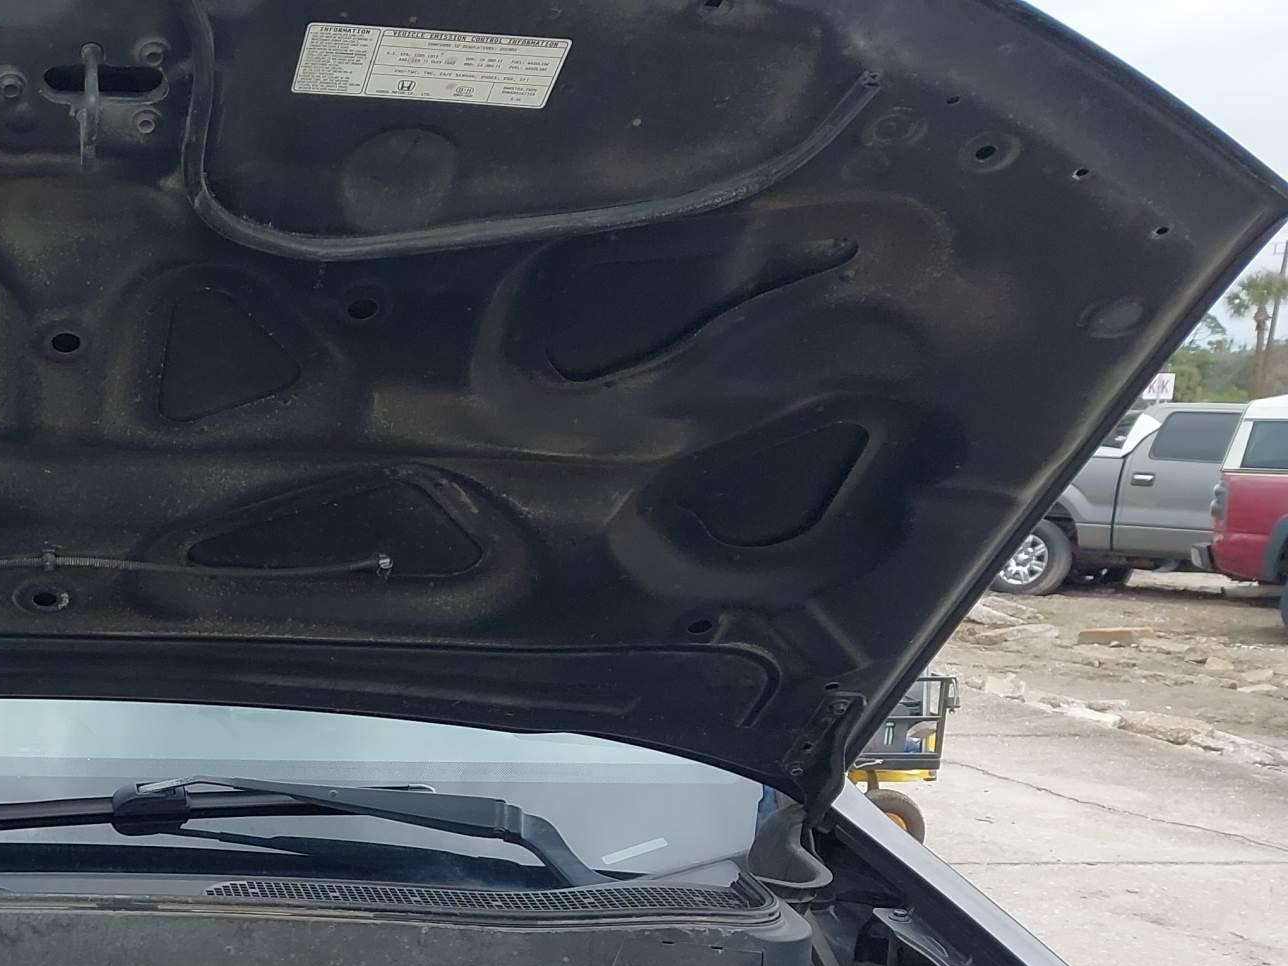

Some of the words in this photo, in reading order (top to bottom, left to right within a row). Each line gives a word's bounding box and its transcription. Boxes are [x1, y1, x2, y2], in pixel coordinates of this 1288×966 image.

[320, 26, 371, 35] INFORMATION
[393, 31, 425, 39] VEHICLE
[428, 33, 466, 41] EMISSION
[471, 36, 503, 44] CONTROL
[508, 38, 560, 48] INFORMATION
